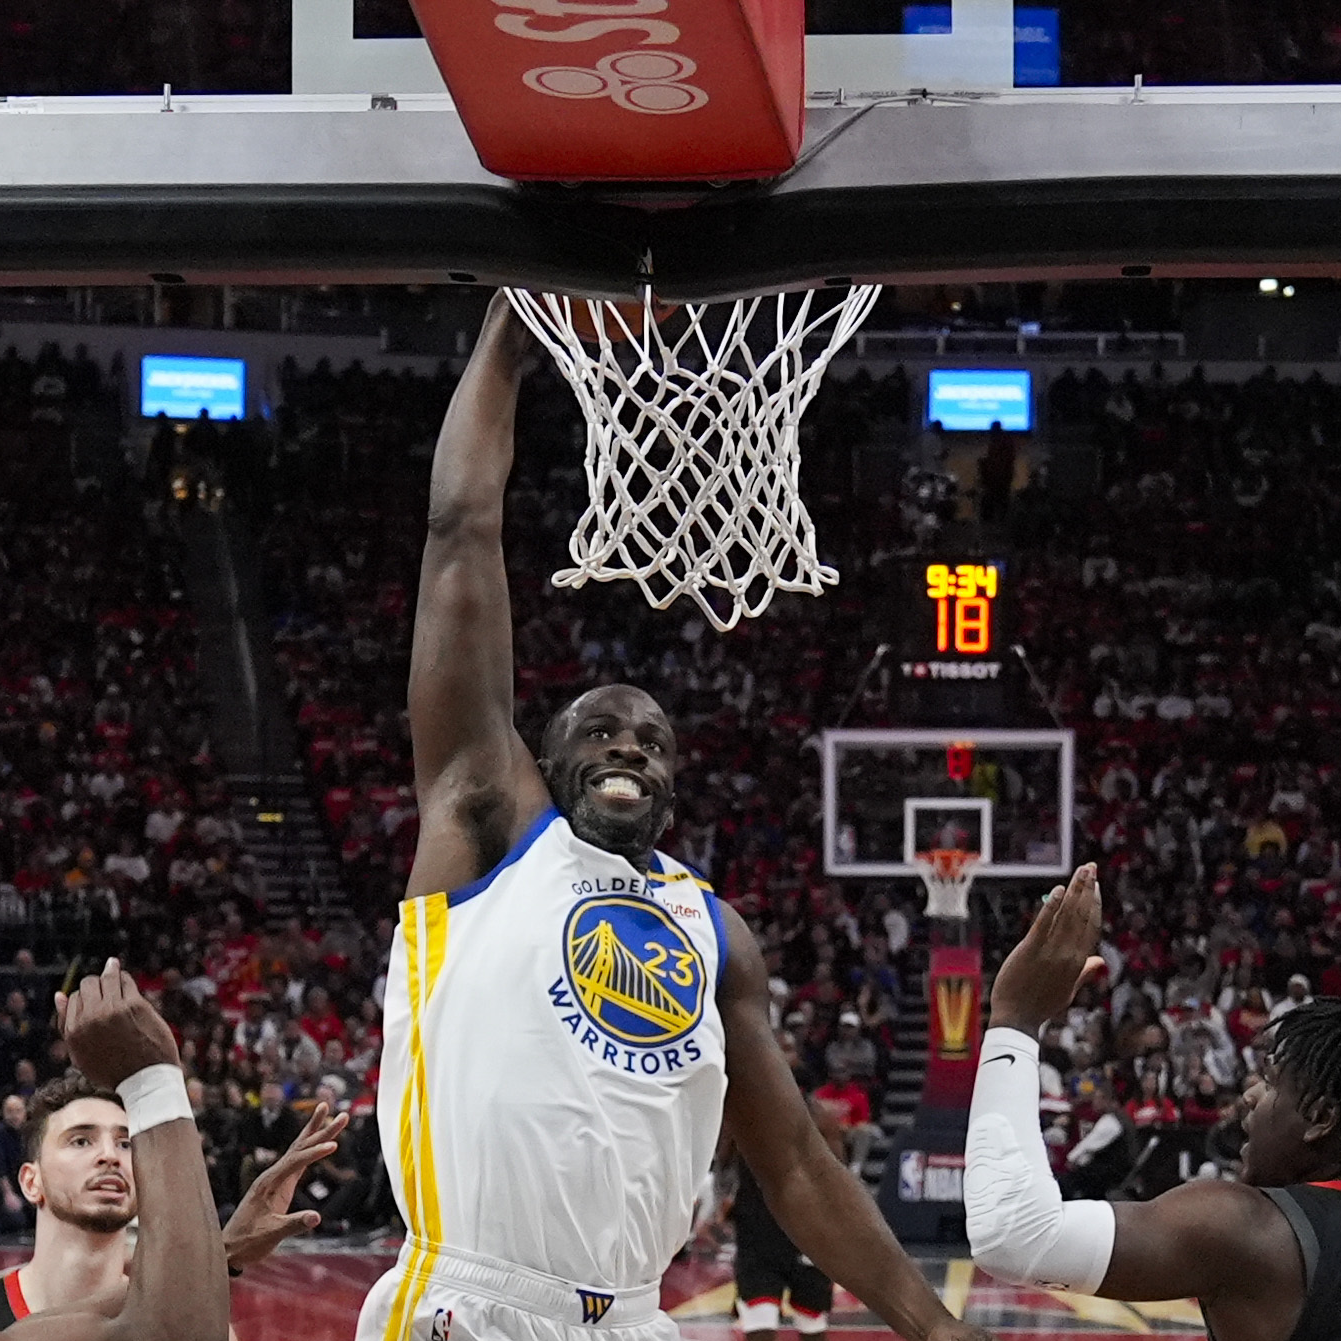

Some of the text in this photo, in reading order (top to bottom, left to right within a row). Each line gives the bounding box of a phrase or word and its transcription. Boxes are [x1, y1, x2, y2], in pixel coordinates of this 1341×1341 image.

[926, 564, 998, 599] 9:34
[937, 597, 990, 654] 18
[571, 877, 655, 898] GOLDEN
[644, 942, 694, 987] 23
[547, 976, 702, 1075] WARRIORS
